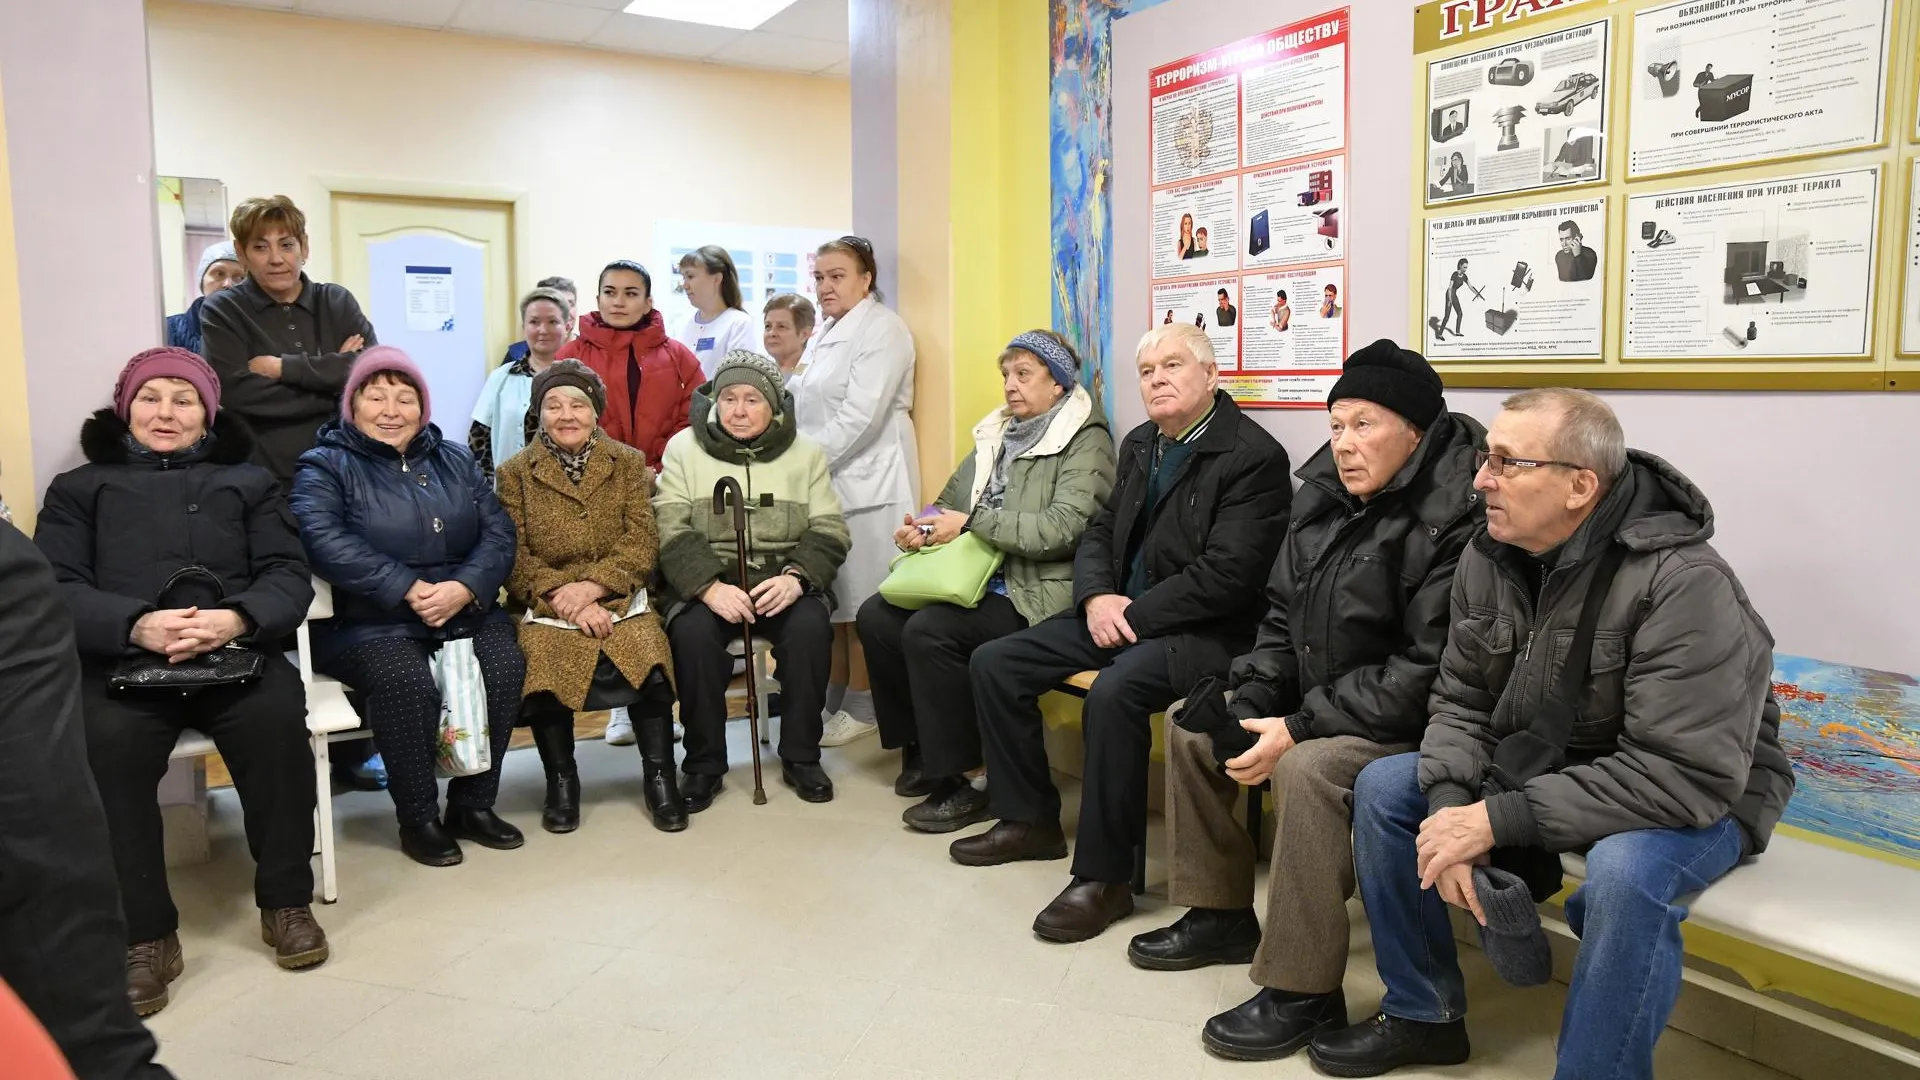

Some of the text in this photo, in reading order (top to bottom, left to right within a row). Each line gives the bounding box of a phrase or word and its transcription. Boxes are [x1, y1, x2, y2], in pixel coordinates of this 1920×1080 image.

[1441, 0, 1576, 38] ГРА
[1656, 26, 1669, 34] ПРИ
[1670, 12, 1728, 30] ВОЗНИКНОВЕНИИ
[1729, 5, 1756, 17] УГРОЗЫ
[1267, 19, 1340, 54] ОБЩЕСТВУ
[1497, 49, 1504, 57] ОБ
[1524, 35, 1564, 50] ЧРЕЗВЫЧАЙНОЙ
[1565, 27, 1593, 41] СИТУАЦИИ
[1726, 85, 1750, 101] МУСОР
[1670, 108, 1824, 139] ПРИ СОВЕРШЕНИИ ТЕРРОРИСТИЧЕСКОГО АКТА
[1655, 178, 1841, 209] ДЕЙСТВИЯ НАСЕЛЕНИЯ ПРИ УГРОЗЕ ТЕРАКТА
[1432, 203, 1599, 230] ЧТО ДЕЛАТЬ ПРИ ОБНАРУЖЕНИИ ВЗРЫВНОГО УСТРОЙСТВА
